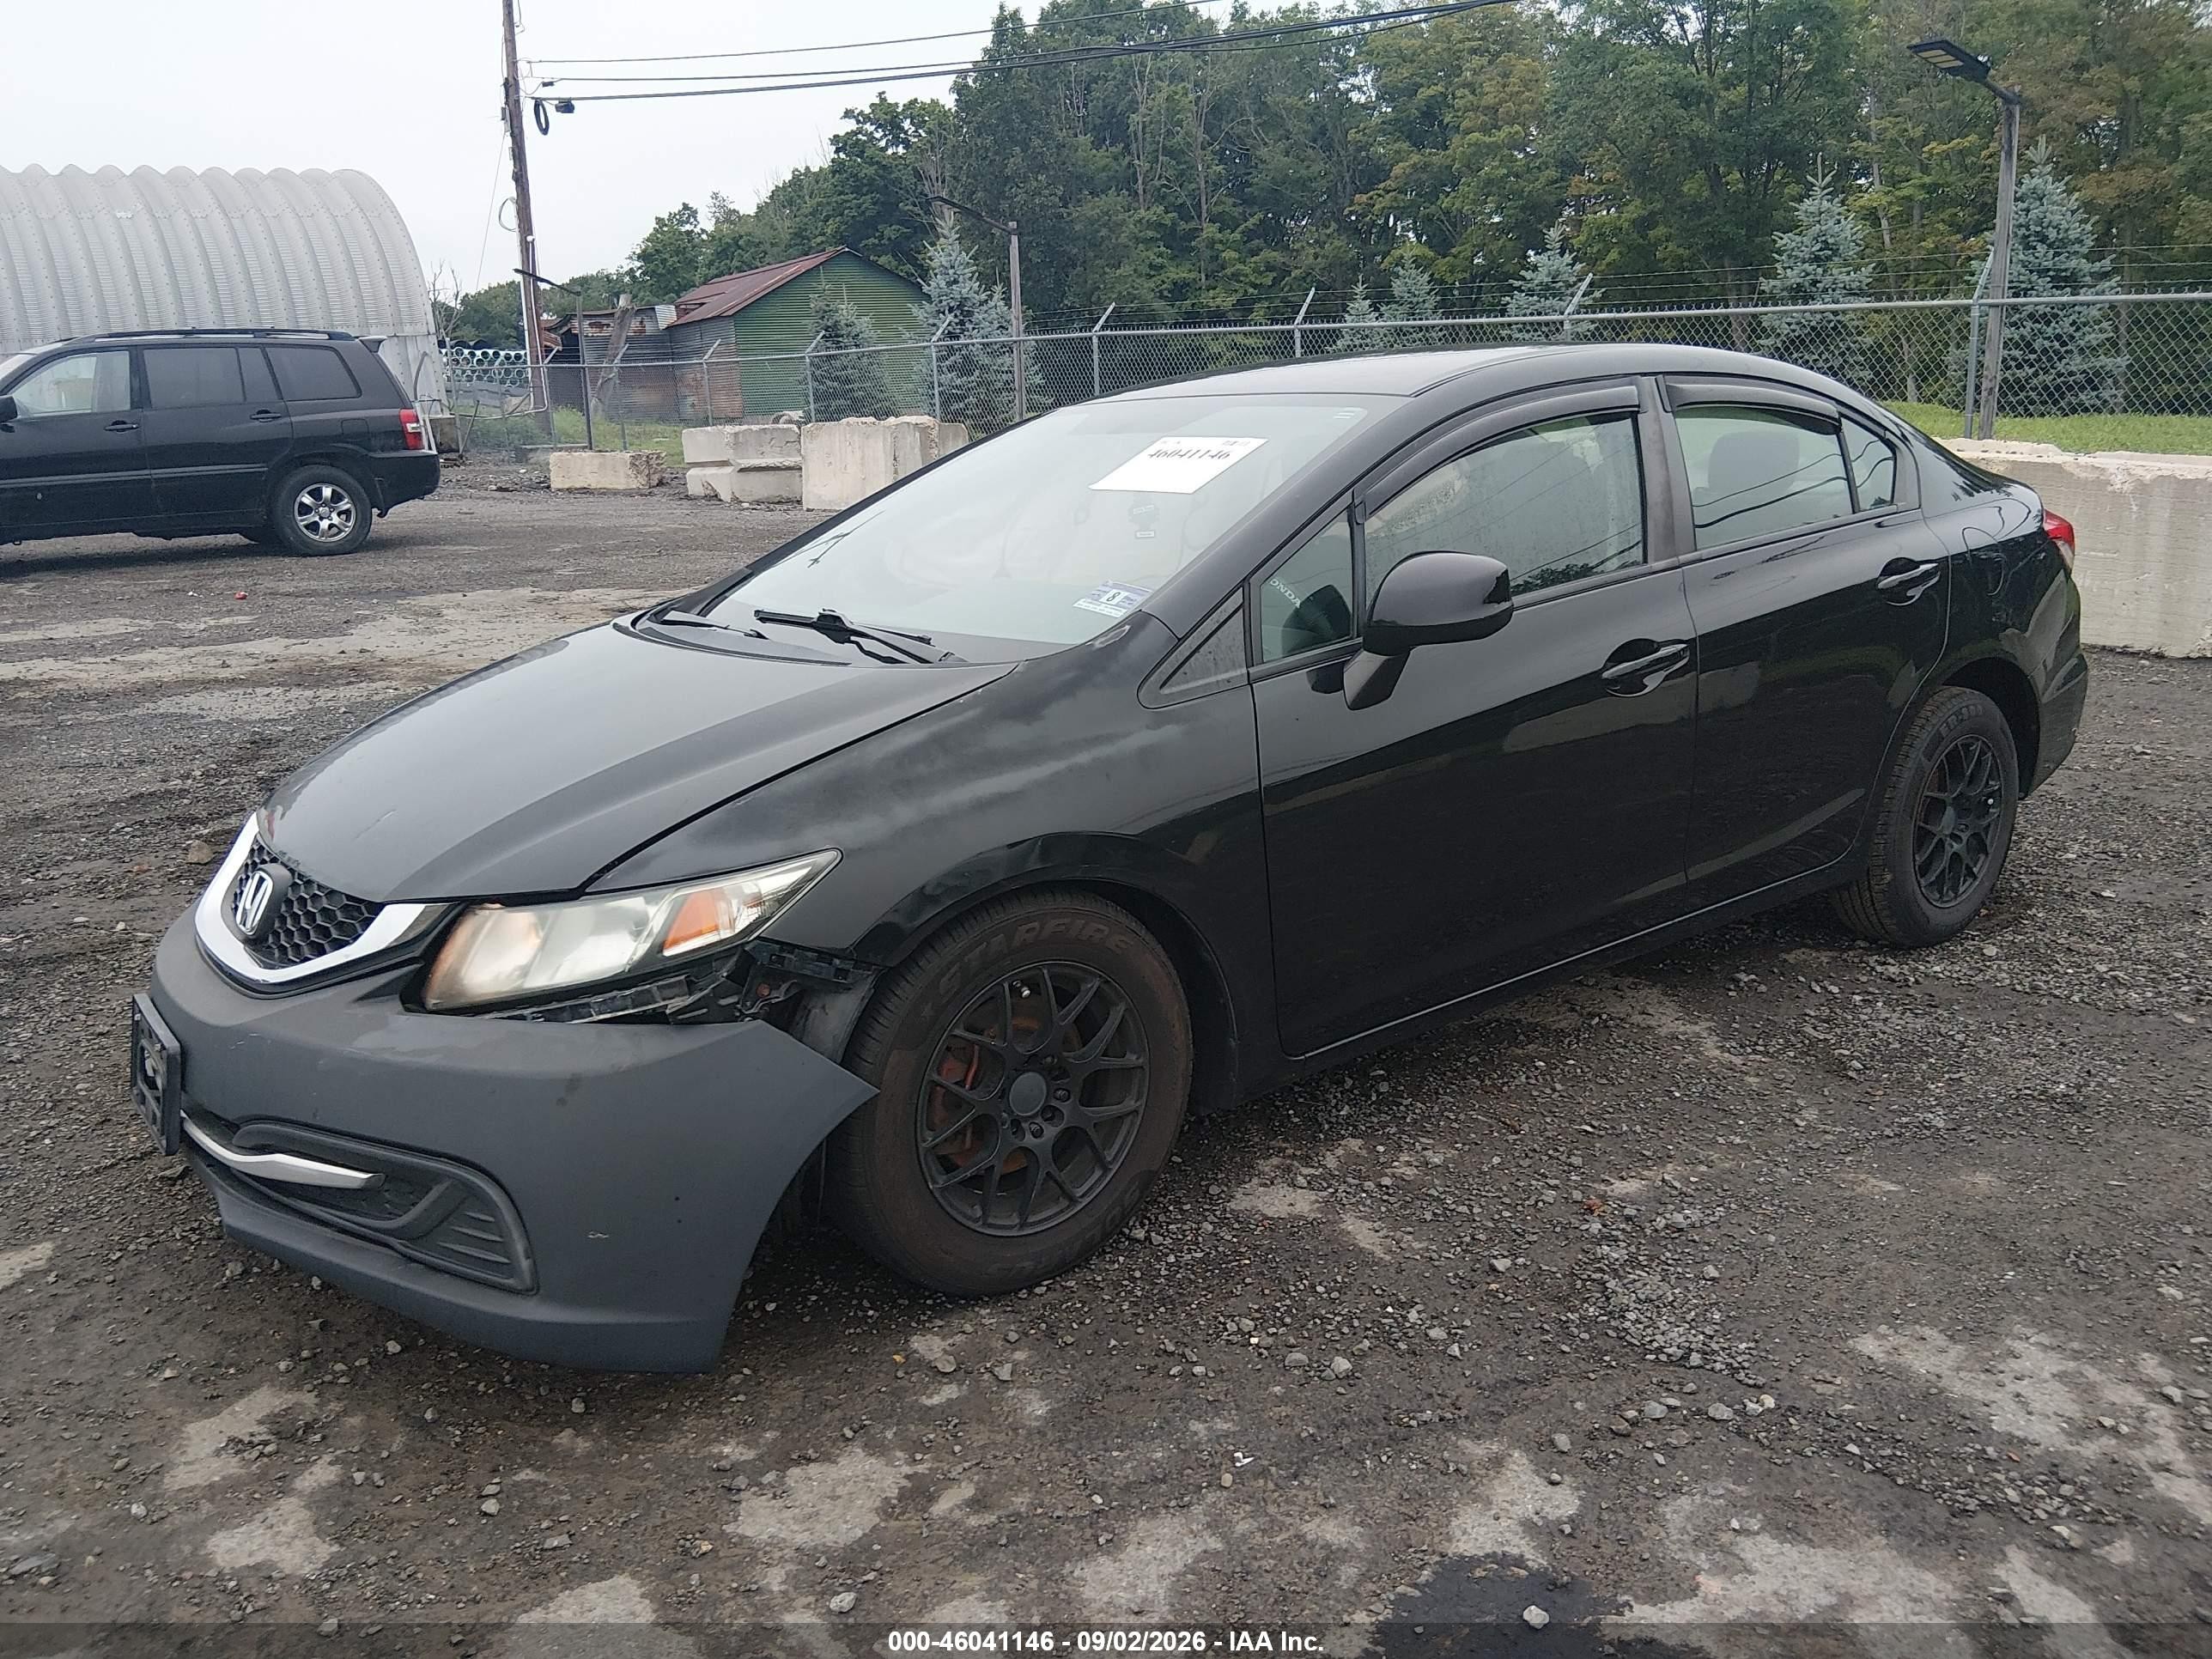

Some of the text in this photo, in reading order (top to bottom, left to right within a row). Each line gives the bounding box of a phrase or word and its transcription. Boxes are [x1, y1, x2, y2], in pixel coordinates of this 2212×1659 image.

[1147, 448, 1231, 459] 46041146
[1106, 591, 1121, 603] 8
[1269, 577, 1301, 610] ONDA
